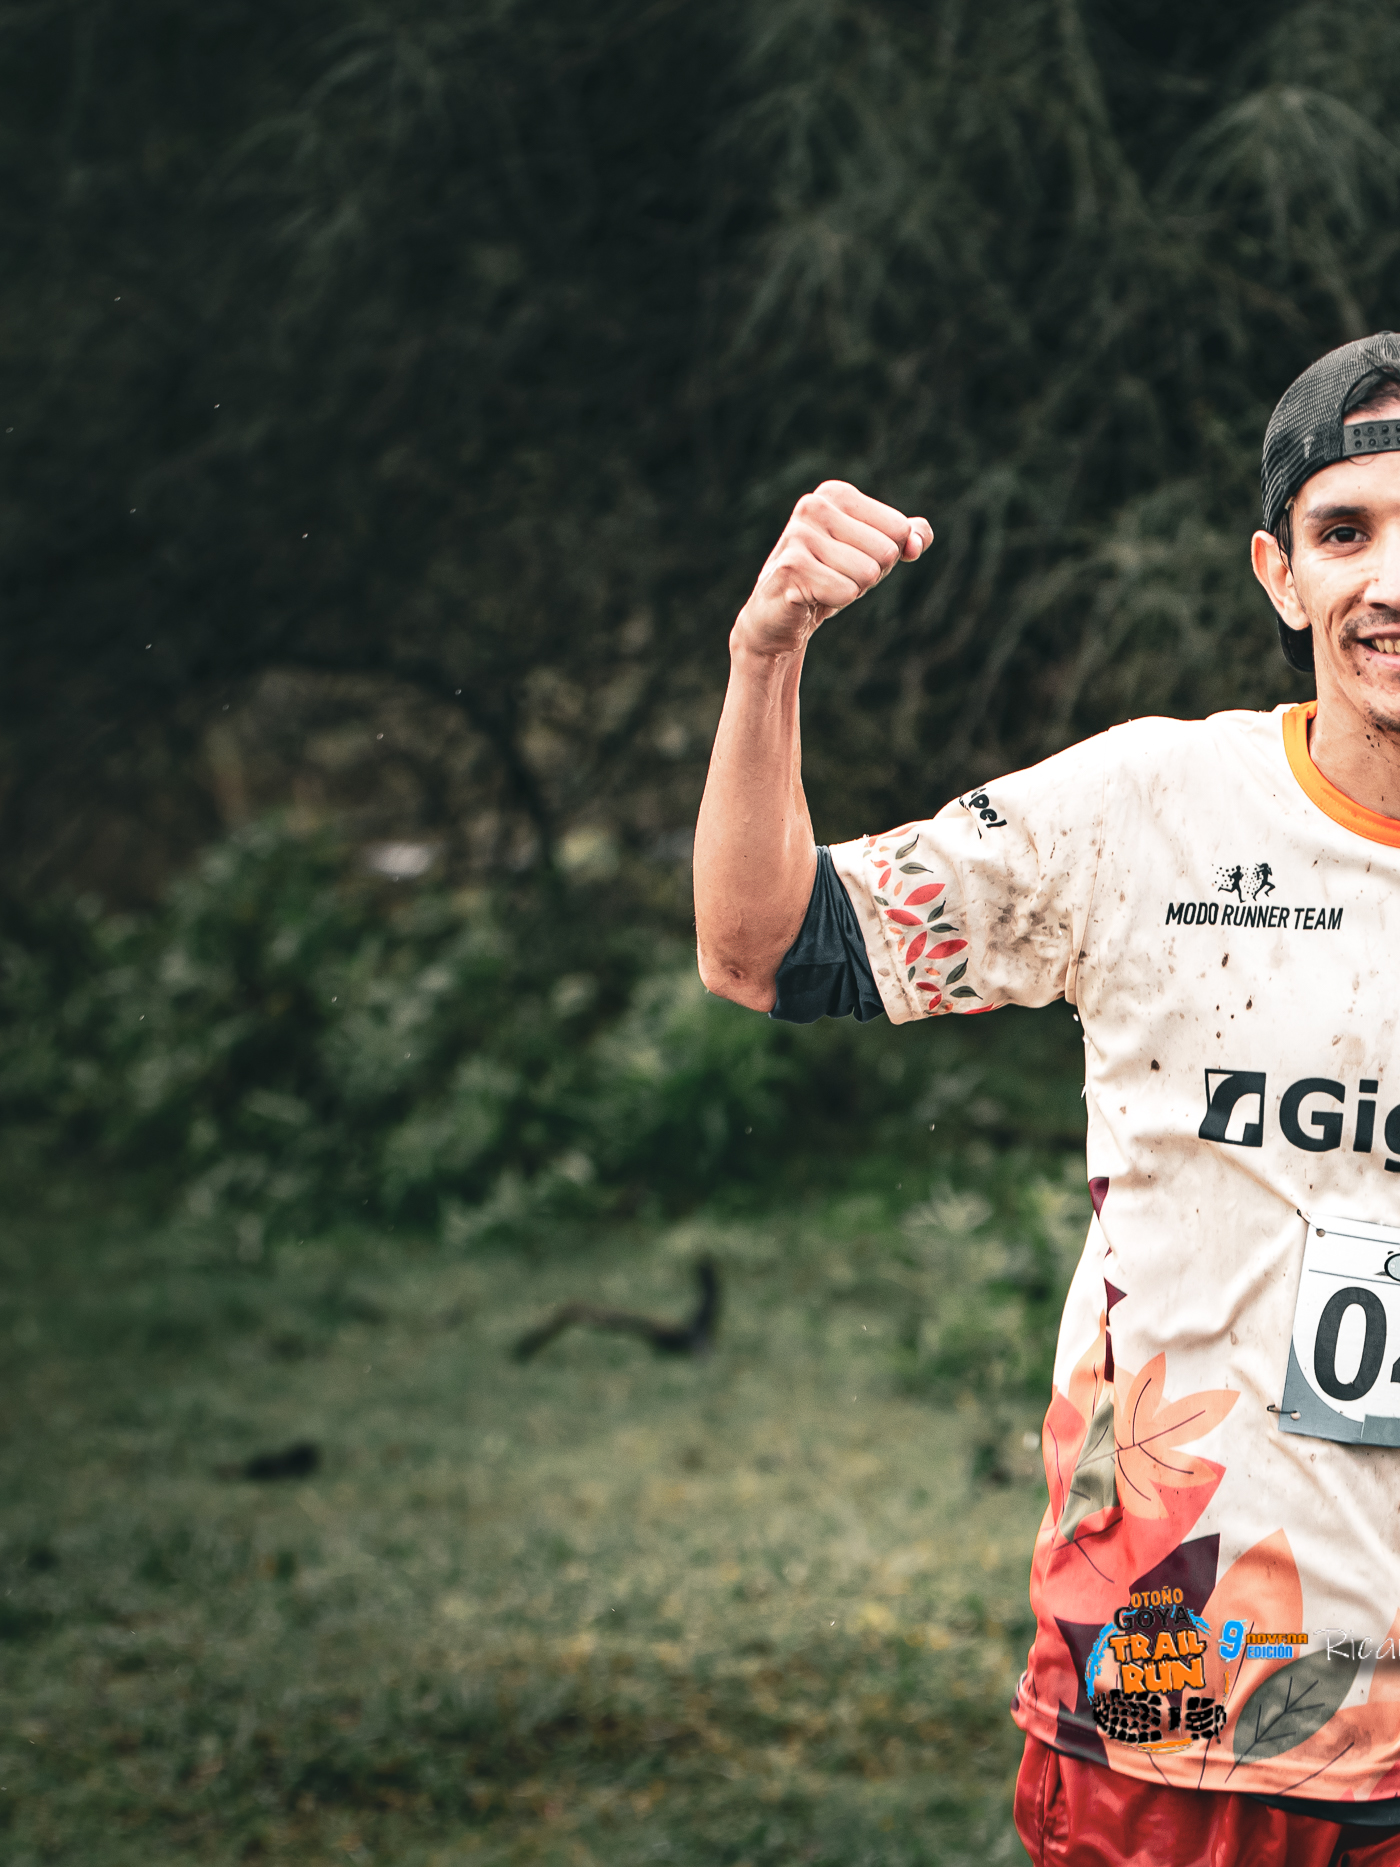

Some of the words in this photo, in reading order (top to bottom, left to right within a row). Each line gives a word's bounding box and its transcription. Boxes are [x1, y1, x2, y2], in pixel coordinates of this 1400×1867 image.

[1165, 902, 1219, 926] MODO
[1220, 904, 1290, 929] RUNNER
[1294, 907, 1344, 931] TEAM
